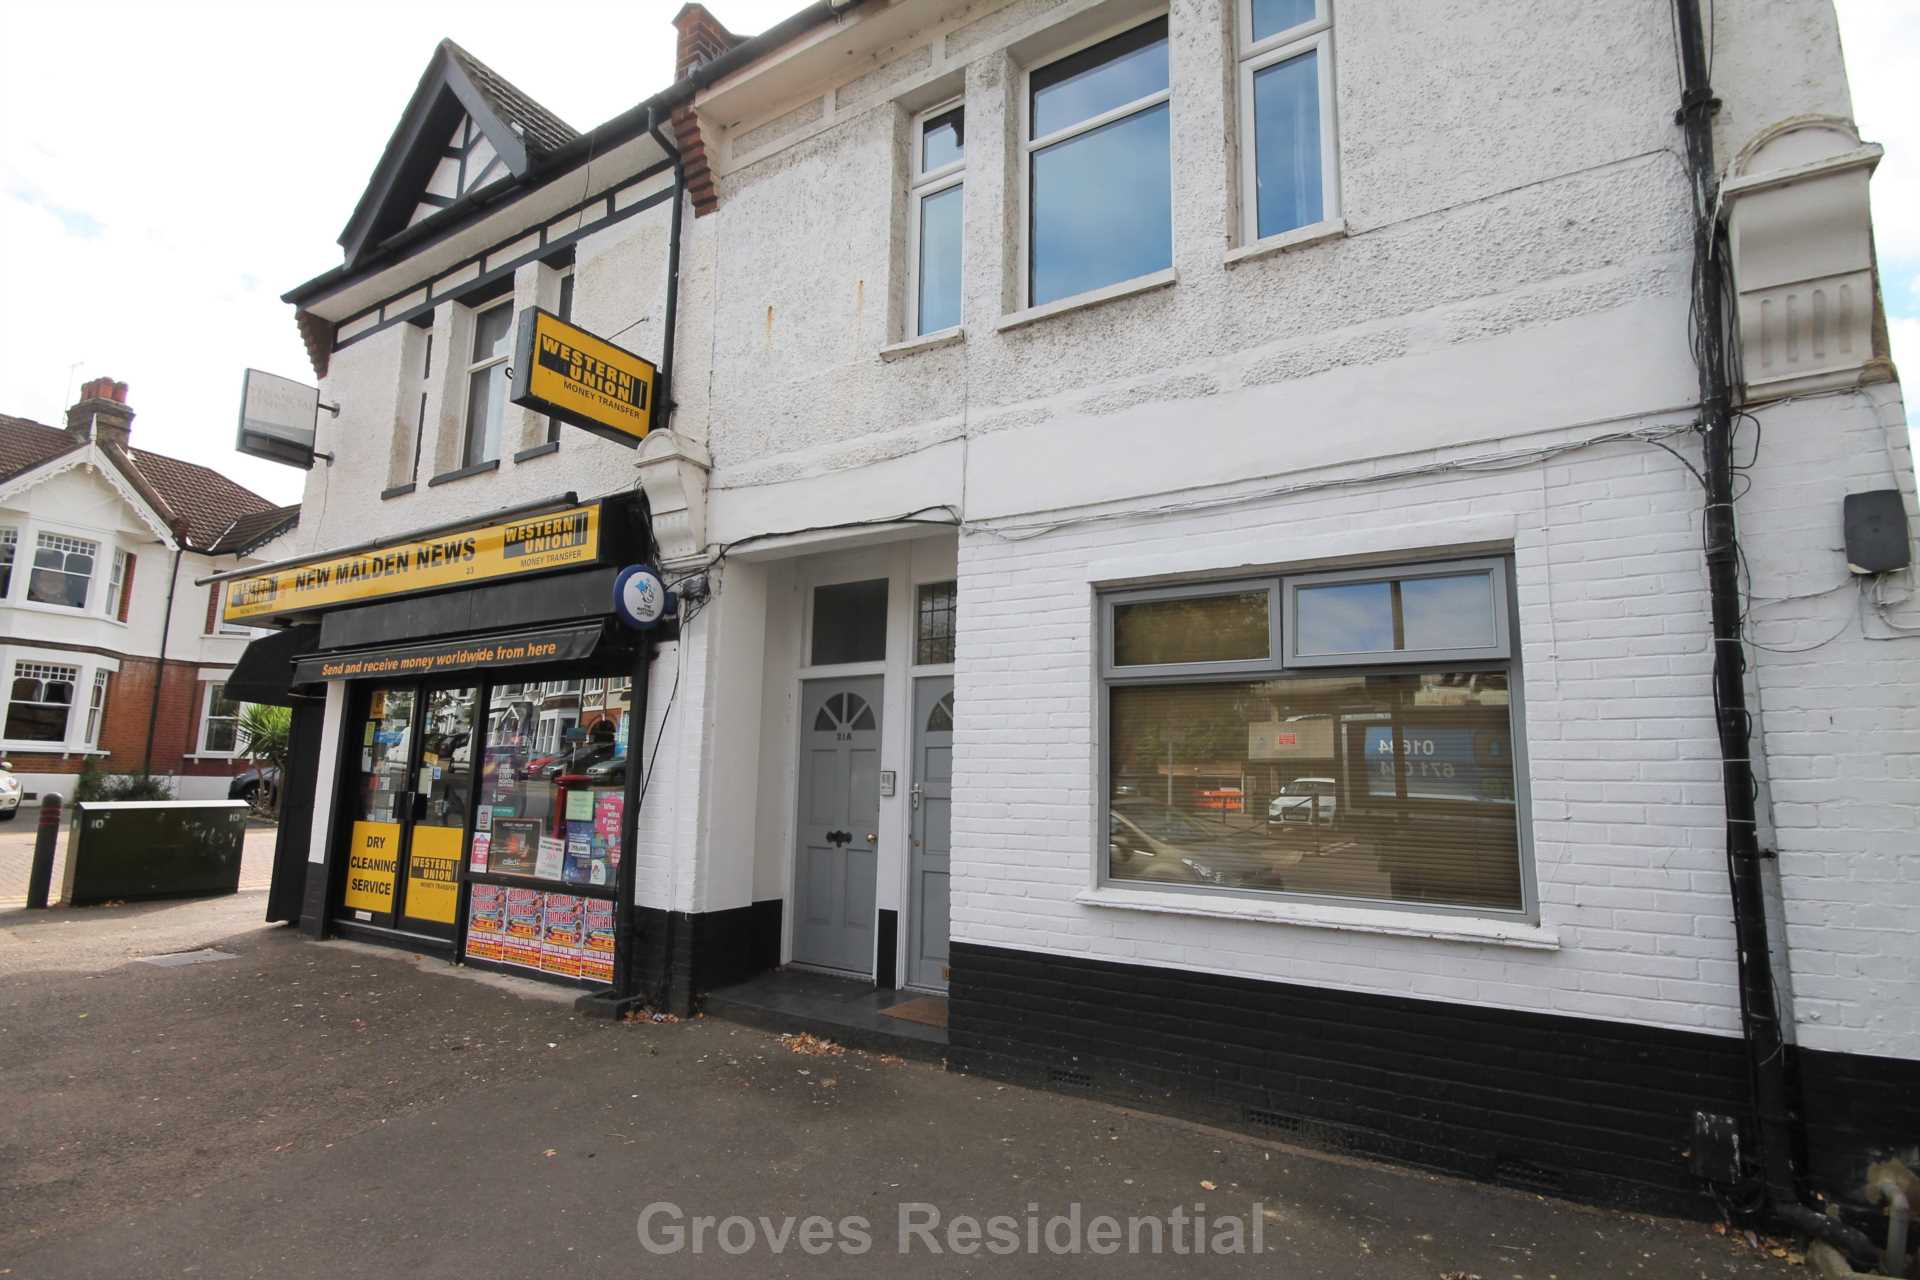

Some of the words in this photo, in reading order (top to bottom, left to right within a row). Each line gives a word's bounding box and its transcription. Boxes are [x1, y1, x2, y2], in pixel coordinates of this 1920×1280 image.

[542, 336, 633, 390] WESTERN
[569, 365, 629, 403] UNION
[563, 381, 596, 401] MONEY
[597, 395, 641, 419] TRANSFER
[505, 517, 574, 543] WESTERN
[524, 532, 572, 554] UNION
[295, 570, 331, 593] NEW
[335, 552, 409, 586] MALDEN
[416, 537, 477, 571] NEWS
[520, 558, 545, 568] MONEY
[547, 550, 582, 563] TRANSFER
[322, 663, 343, 676] Send
[345, 663, 361, 673] and
[363, 656, 399, 672] receive
[400, 655, 434, 672] money
[437, 647, 493, 665] worldwide
[497, 645, 524, 661] from
[528, 642, 556, 657] here
[366, 836, 385, 849] DRY
[350, 855, 398, 873] CLEANING
[411, 856, 452, 871] WESTERN
[423, 868, 451, 882] UNION
[351, 877, 391, 896] SERVICE
